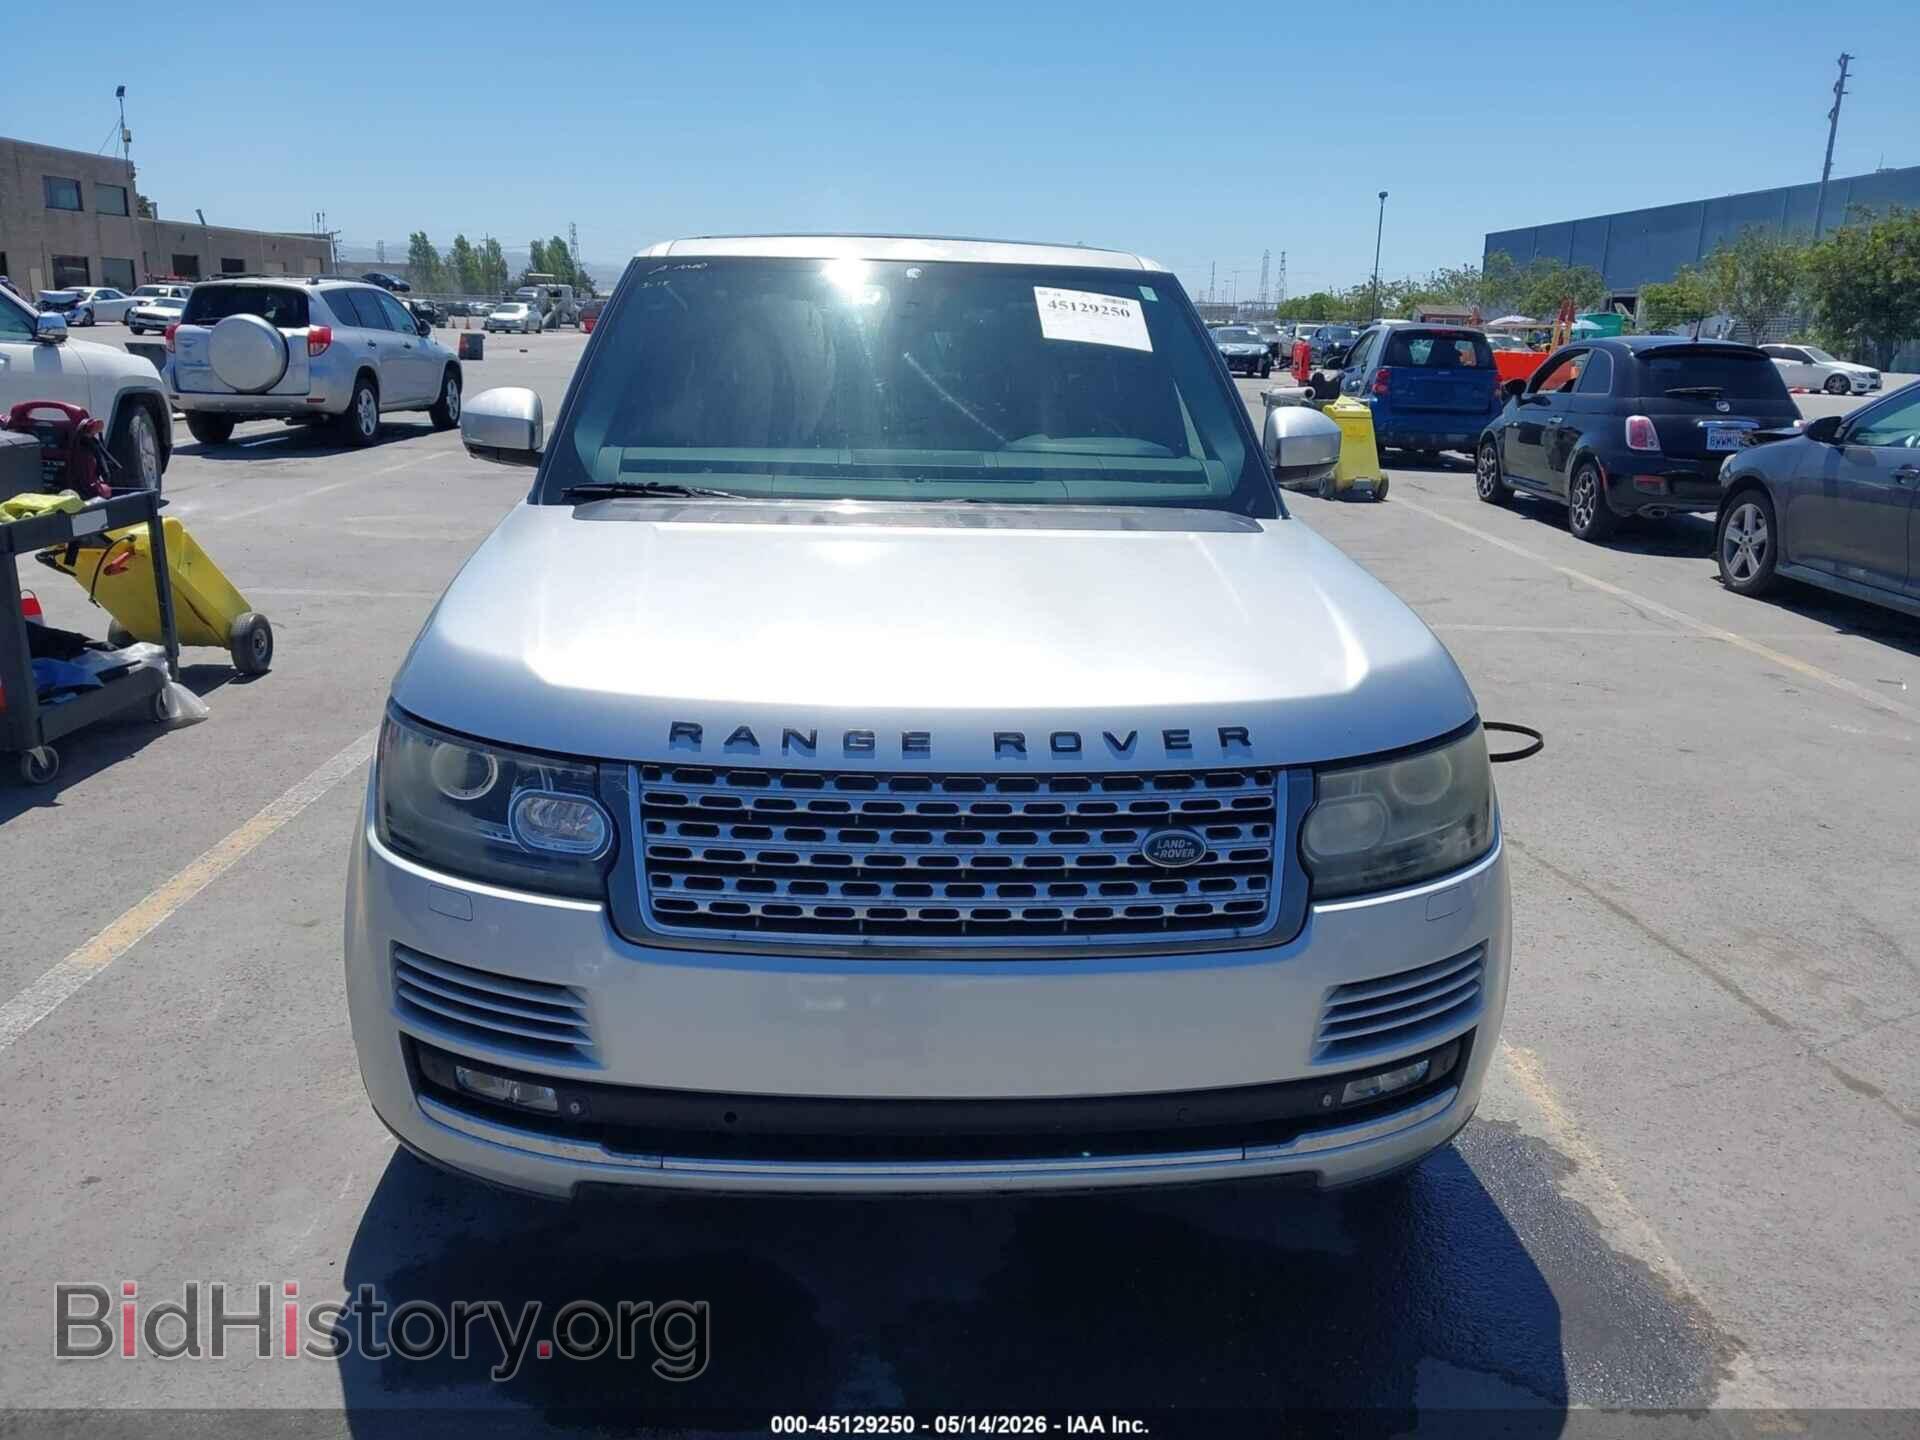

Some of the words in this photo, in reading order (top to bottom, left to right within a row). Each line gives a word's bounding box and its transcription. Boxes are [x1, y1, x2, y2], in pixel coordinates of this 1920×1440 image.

[1048, 299, 1131, 318] 45129250
[669, 721, 931, 752] RANGE
[993, 726, 1252, 753] ROVER
